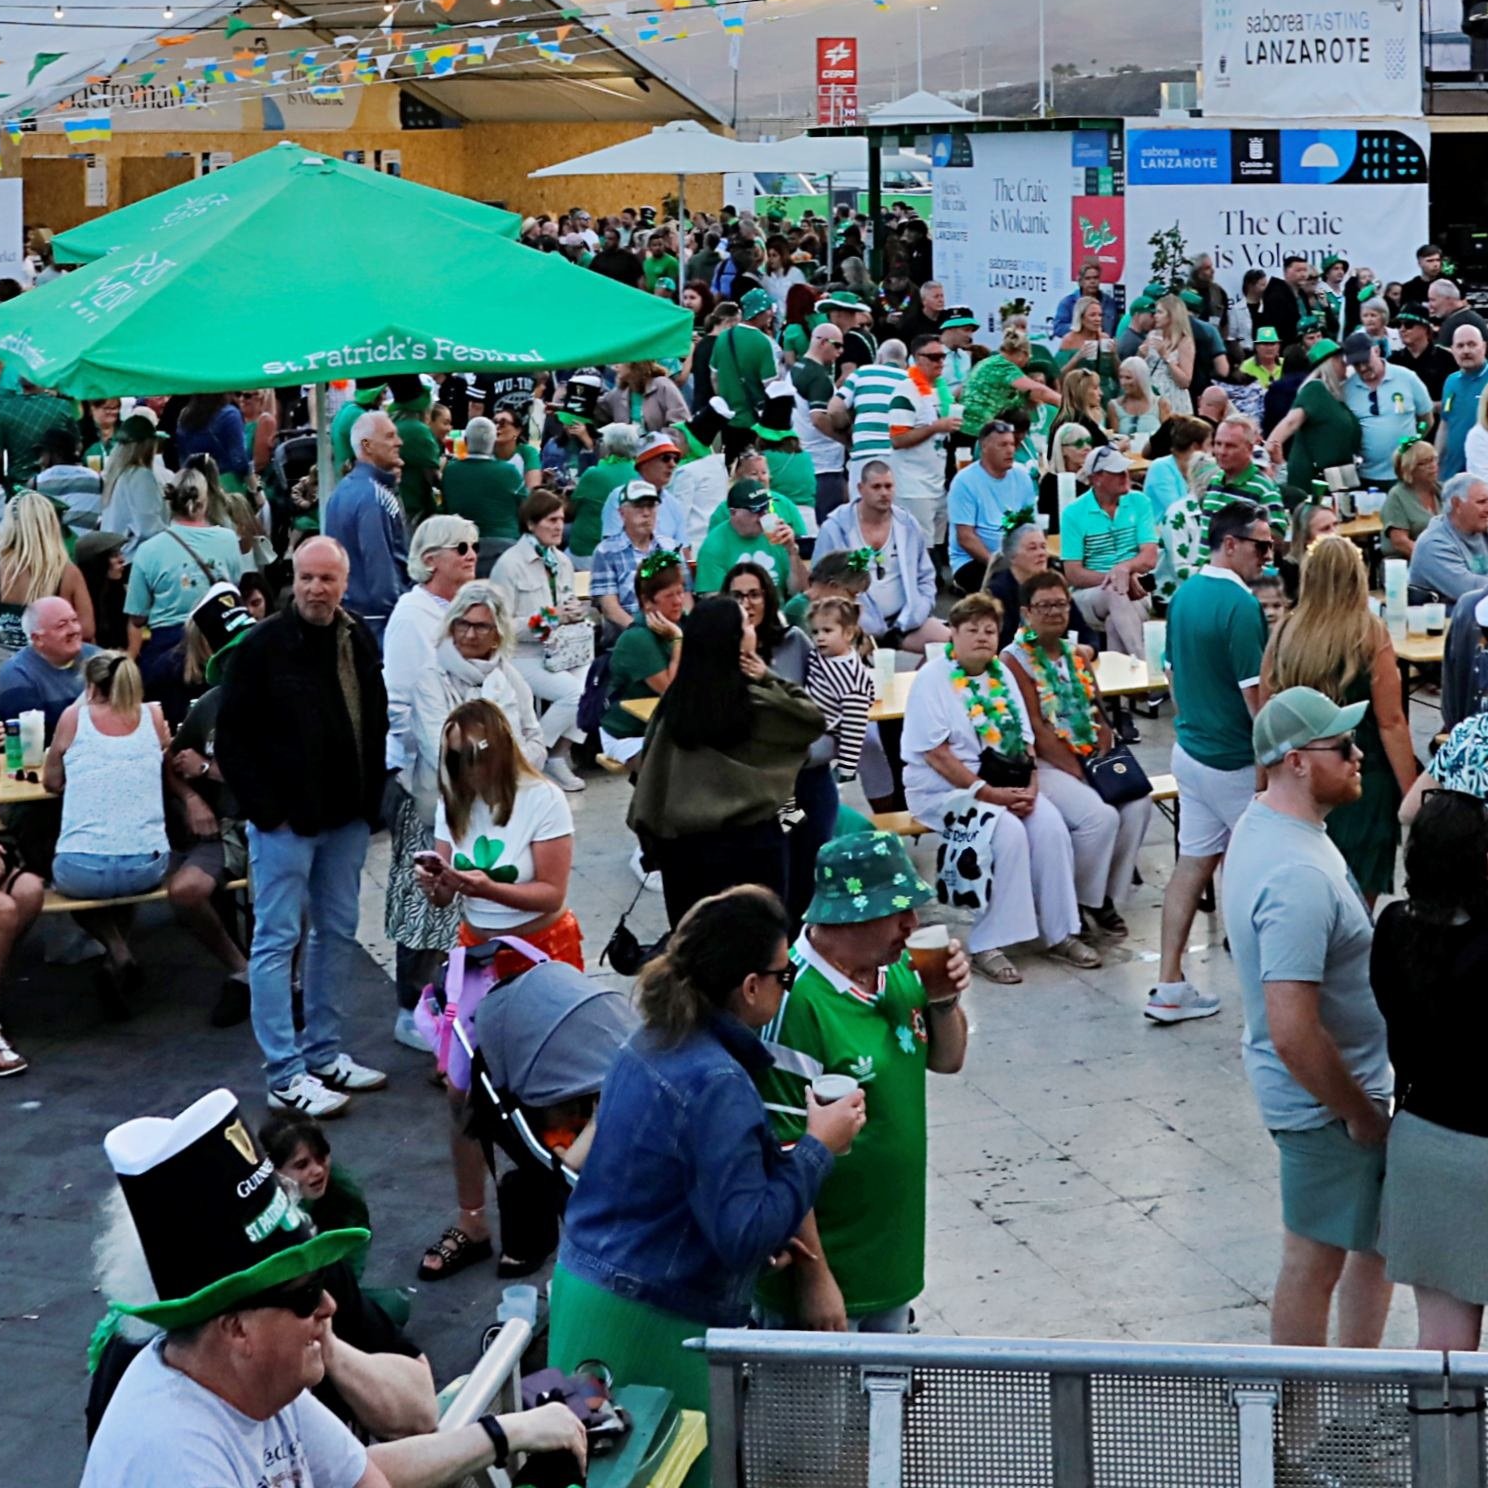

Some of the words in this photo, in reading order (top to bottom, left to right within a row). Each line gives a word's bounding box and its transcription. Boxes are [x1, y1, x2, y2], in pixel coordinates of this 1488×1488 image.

[1244, 37, 1370, 65] LANZAROTE
[1140, 157, 1218, 169] LANZAROTE
[993, 177, 1015, 203] The
[1016, 178, 1049, 203] Craic
[989, 209, 1000, 233] is
[1000, 209, 1051, 235] Volcanic
[1219, 210, 1271, 236] The
[1276, 210, 1344, 237] Craic
[1214, 244, 1235, 268] is
[988, 273, 1048, 292] LANZAROTE
[304, 335, 427, 370] Patrick's
